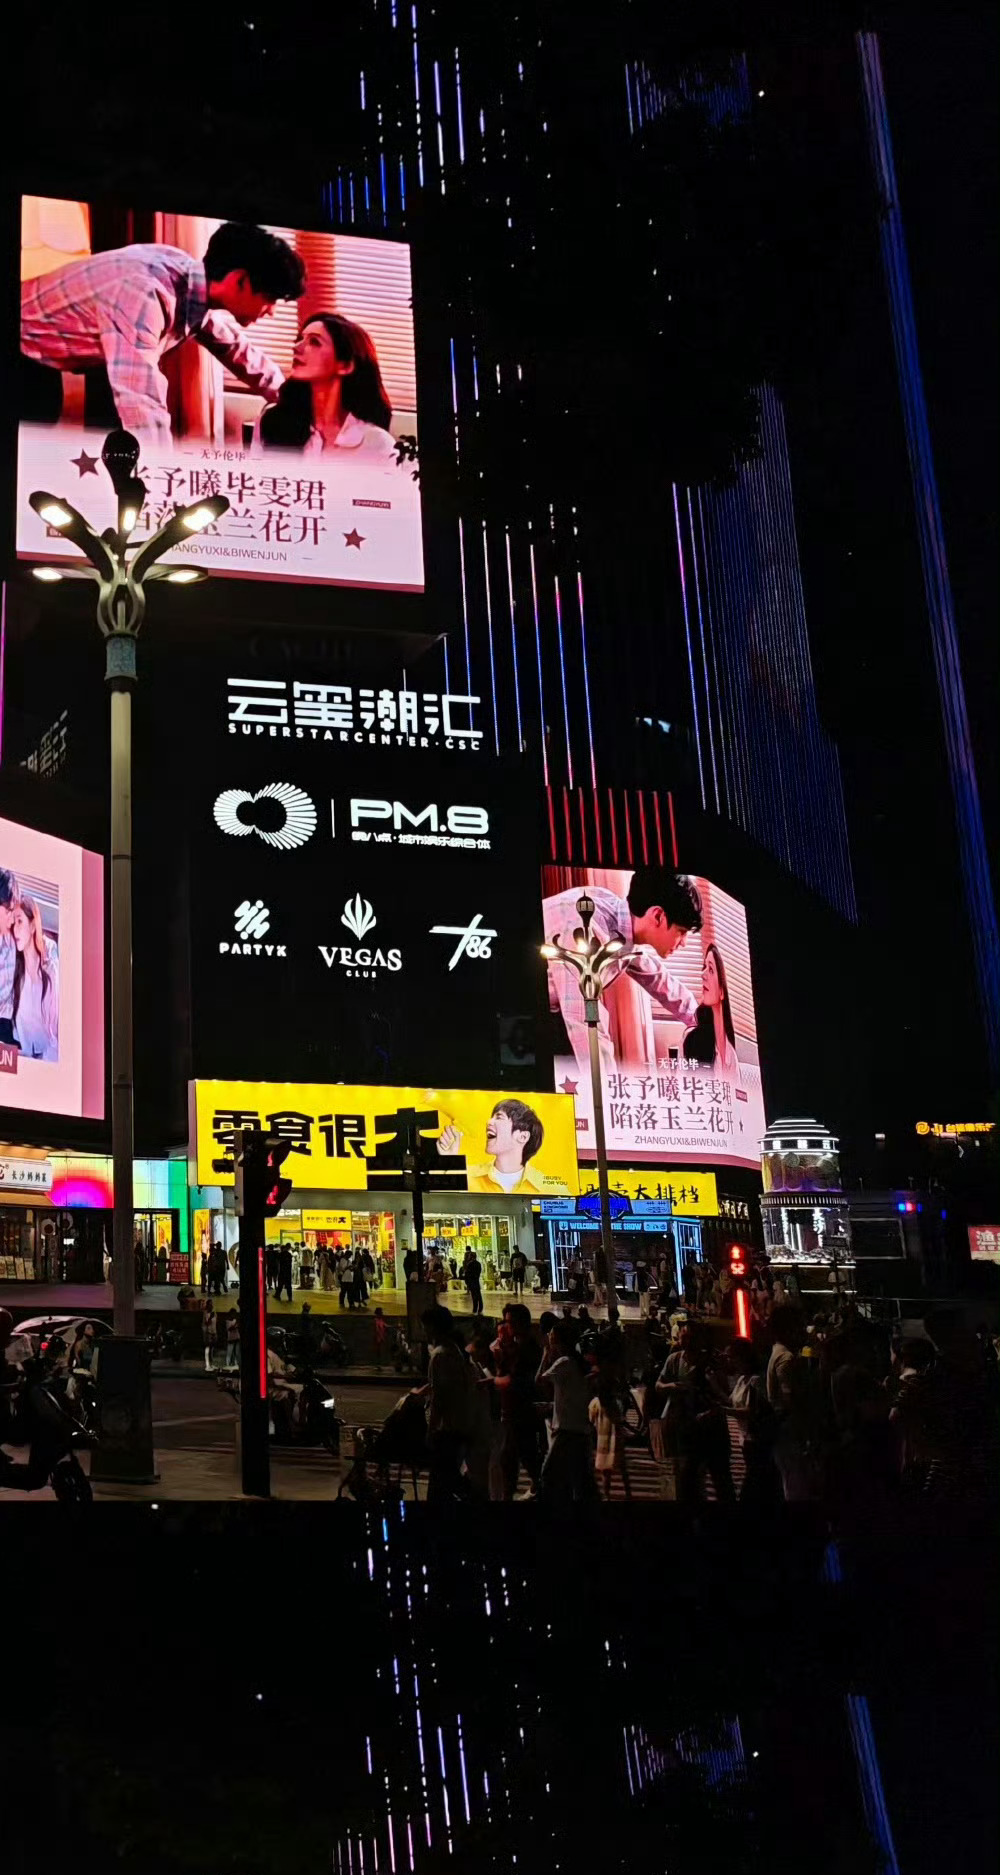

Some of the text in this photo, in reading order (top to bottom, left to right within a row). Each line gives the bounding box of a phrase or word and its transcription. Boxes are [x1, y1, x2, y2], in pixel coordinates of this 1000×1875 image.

[350, 799, 489, 835] PM.8
[219, 942, 287, 957] PARTYK
[318, 945, 403, 972] VEGAS
[346, 970, 377, 979] CLUB
[610, 1103, 734, 1135] 陷落玉兰花开
